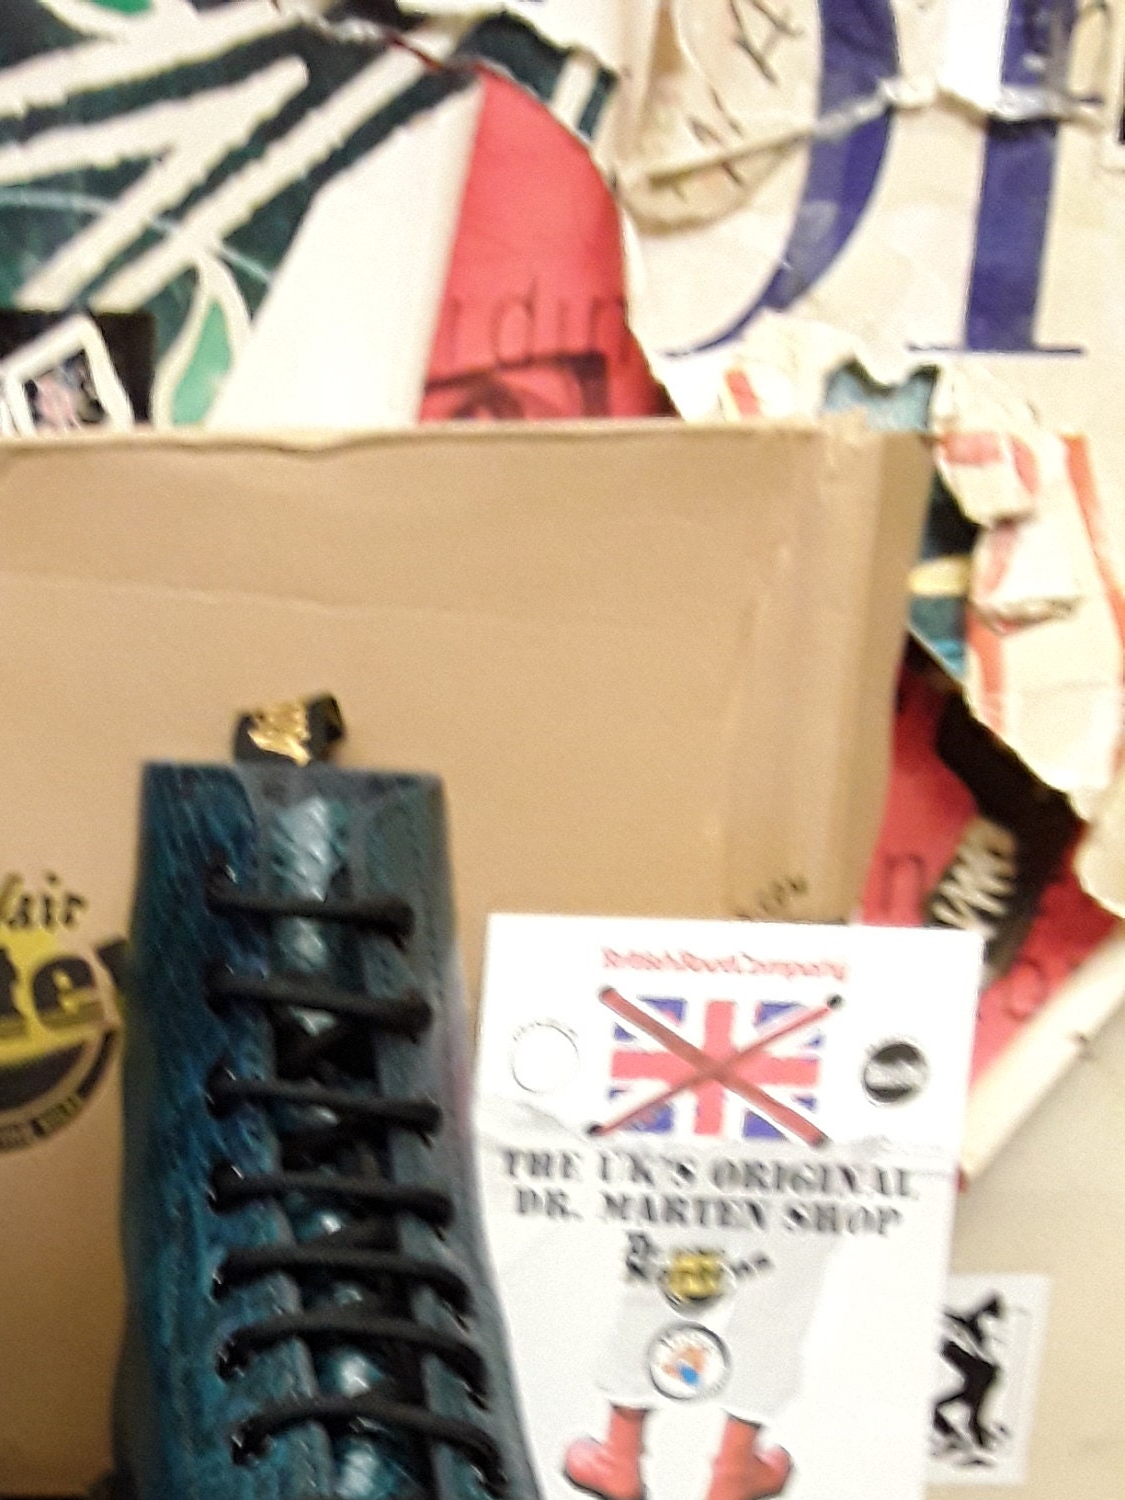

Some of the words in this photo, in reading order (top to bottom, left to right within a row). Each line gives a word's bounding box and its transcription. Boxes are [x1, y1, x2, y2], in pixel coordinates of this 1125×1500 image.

[502, 1148, 581, 1181] THE
[710, 1155, 918, 1200] ORIGINAL
[599, 1189, 772, 1232] MARTEN
[782, 1200, 904, 1238] SHOP
